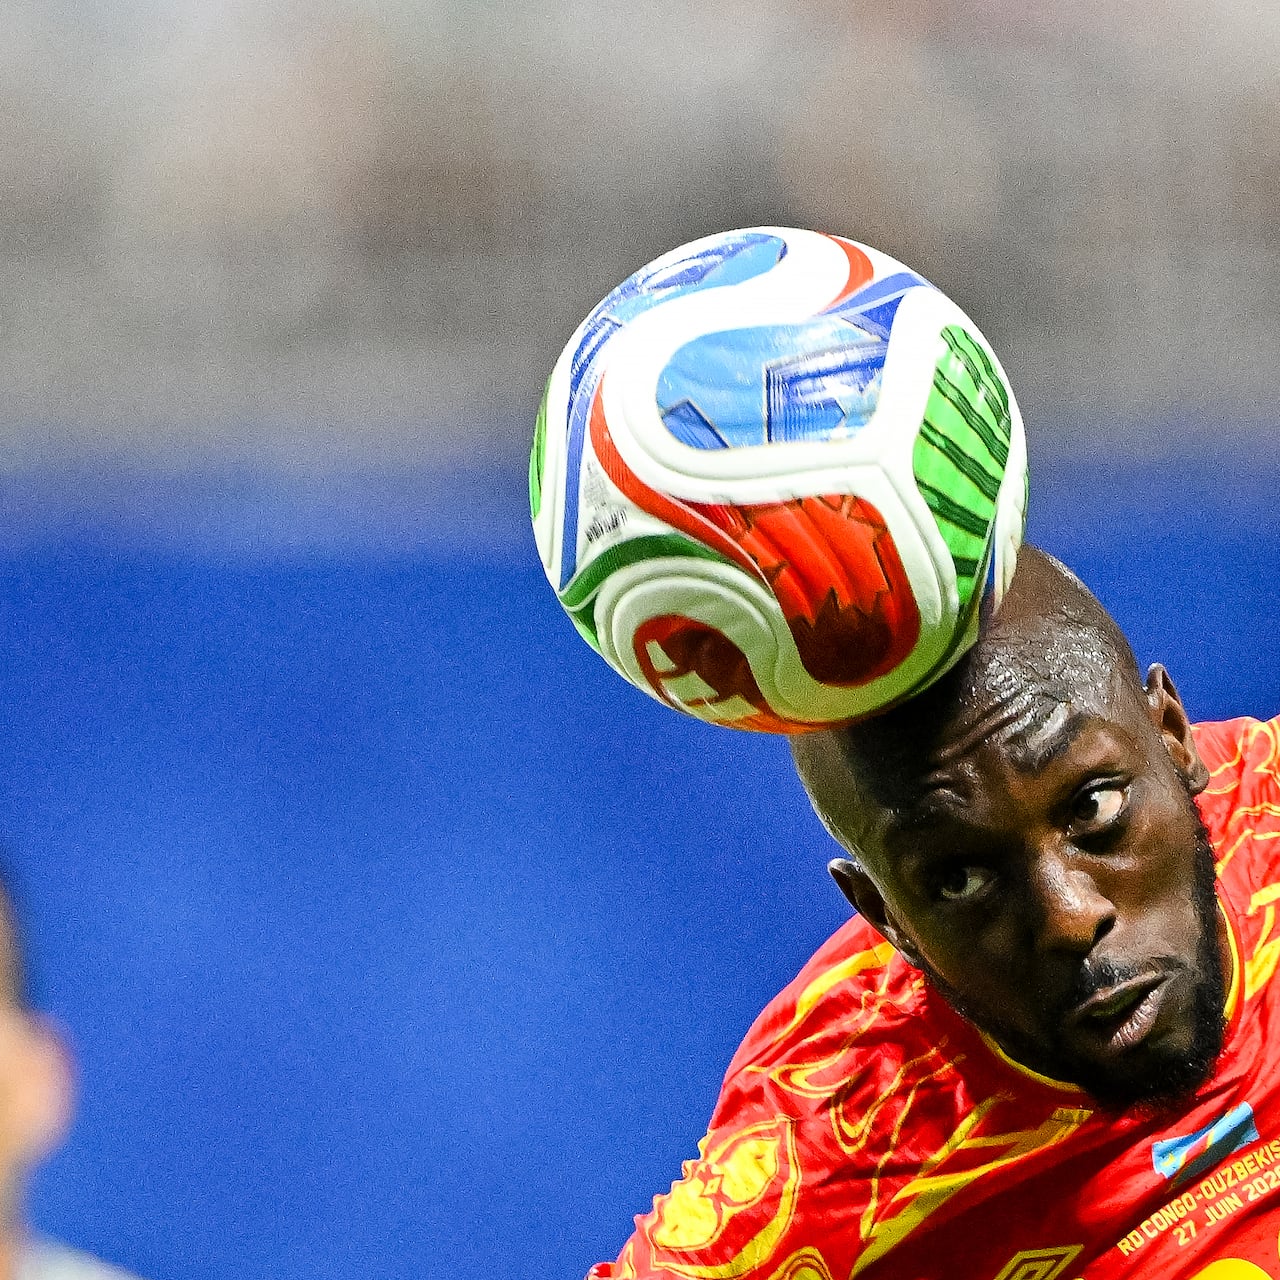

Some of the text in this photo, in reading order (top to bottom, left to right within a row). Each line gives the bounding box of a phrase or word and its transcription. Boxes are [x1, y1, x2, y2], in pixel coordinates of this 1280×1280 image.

[1172, 1220, 1197, 1247] 27
[1205, 1192, 1244, 1227] JUIN
[1116, 1229, 1144, 1256] RD
